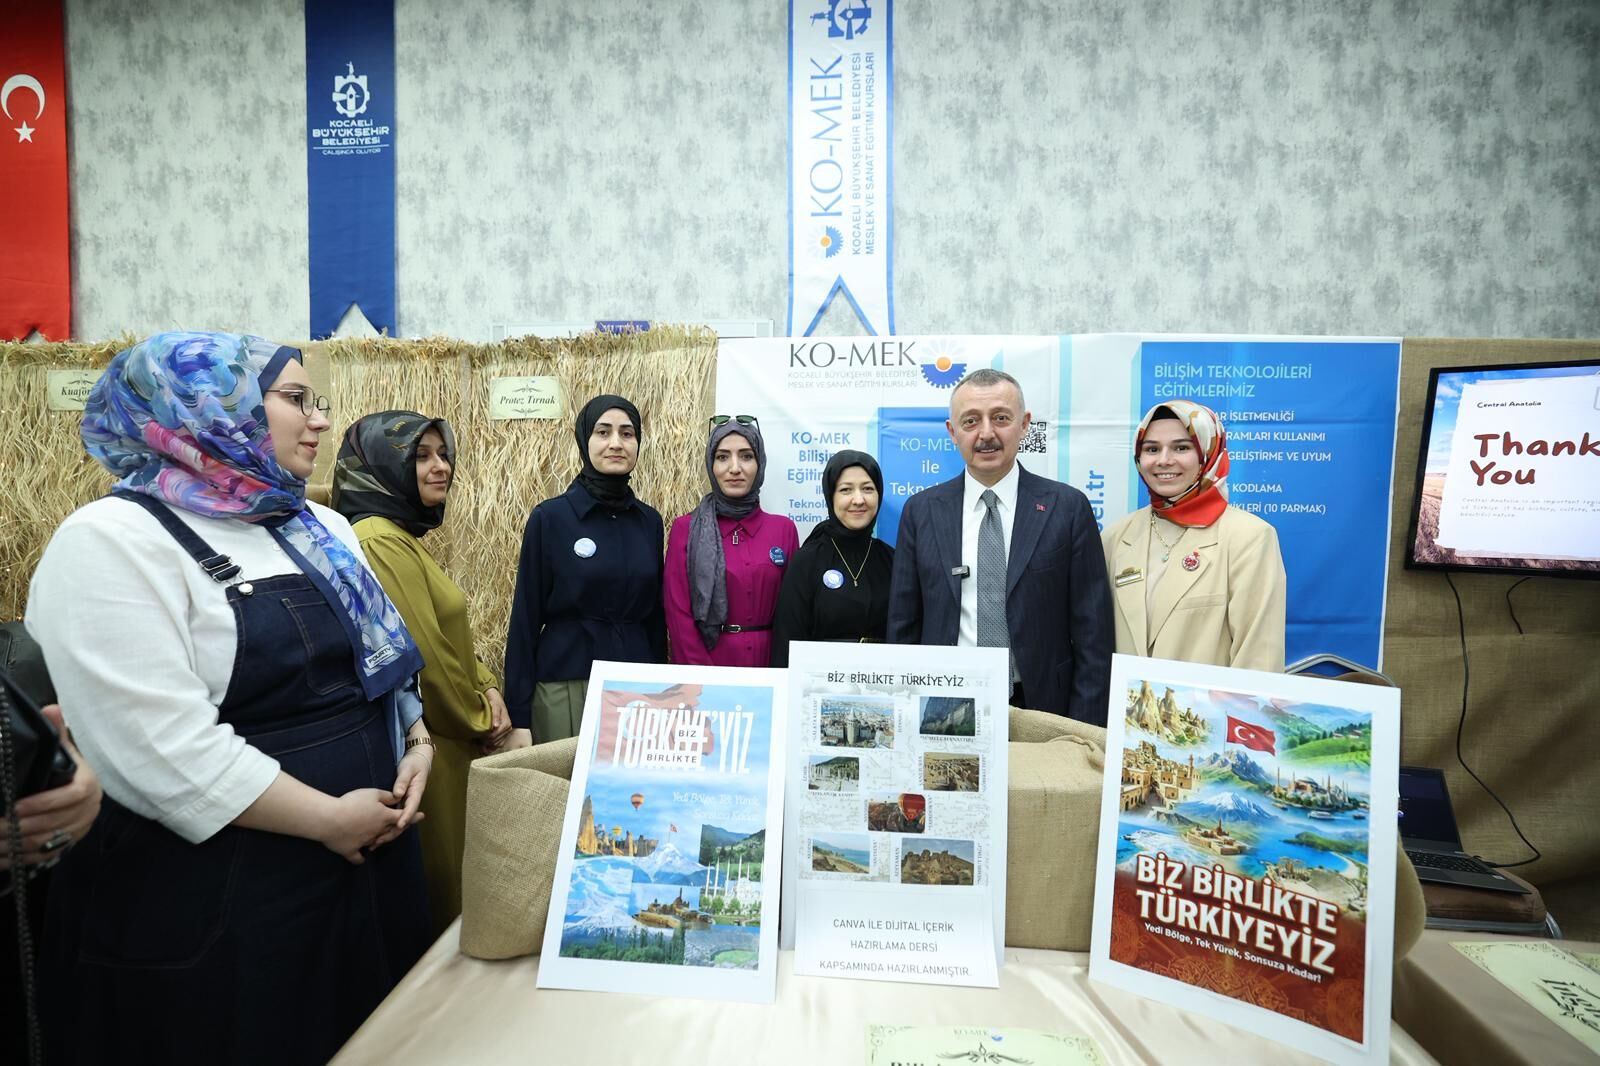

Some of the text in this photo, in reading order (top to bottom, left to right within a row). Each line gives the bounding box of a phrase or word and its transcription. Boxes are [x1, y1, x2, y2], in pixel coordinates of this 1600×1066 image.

[850, 52, 862, 120] BELEDİYESİ
[865, 52, 875, 107] KURSLARI
[329, 119, 374, 128] KOCAELİ
[312, 126, 390, 138] BÜYÜKŞEHİR
[809, 55, 843, 217] KO-MEK
[322, 136, 381, 146] BELEDİYESİ
[865, 154, 875, 190] SANAT
[865, 194, 875, 207] VE
[852, 204, 862, 256] KOCAELİ
[865, 211, 875, 255] MESLEK
[789, 341, 917, 368] KO-MEK
[1154, 362, 1313, 381] BİLİŞİM TEKNOLOJİLERİ
[1154, 383, 1256, 398] EĞİTİMLERİMİZ
[1477, 400, 1542, 409] Central Anatolia
[1230, 410, 1295, 422] İŞLETMENLİĞİ
[791, 431, 851, 445] KO-MEK
[1225, 431, 1326, 442] RAMLARI KULLANIMI
[1473, 431, 1600, 458] Thank
[799, 449, 836, 464] Bilişi
[1228, 449, 1332, 462] GELİŞTİRME VE UYUM
[922, 460, 940, 474] ile
[1469, 460, 1536, 487] You
[889, 481, 939, 496] Tekn
[1232, 484, 1283, 494] KODLAMA
[1264, 503, 1278, 515] (10
[1281, 504, 1327, 516] PARMAK)
[828, 670, 845, 684] BİZ
[850, 671, 894, 685] BİRLİKTE
[678, 729, 697, 738] BİZ
[646, 753, 698, 764] BİRLİKTE
[1137, 852, 1338, 934] BİZ BİRLİKTE
[833, 918, 955, 934] CANVA İLE DİJİTAL İÇERİK
[1136, 889, 1337, 975] TÜRKİYEYİZ
[850, 939, 938, 953] HAZIRLAMA DERSİ
[1144, 921, 1322, 984] Yedi Bölge, Tek Yürek, Sonsuza Kadar!
[819, 960, 885, 974] KAPSAMINDA
